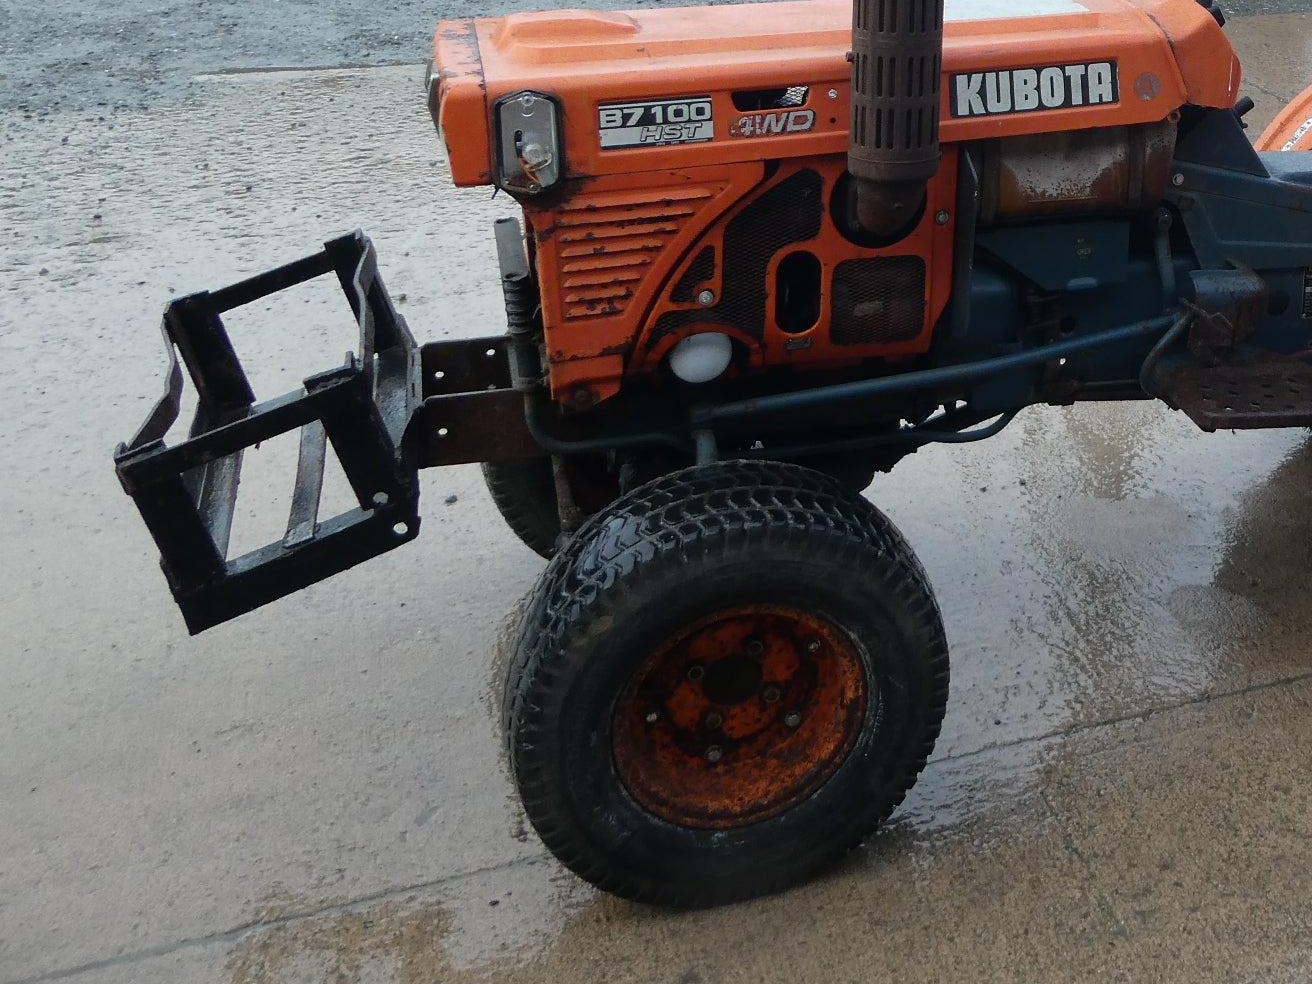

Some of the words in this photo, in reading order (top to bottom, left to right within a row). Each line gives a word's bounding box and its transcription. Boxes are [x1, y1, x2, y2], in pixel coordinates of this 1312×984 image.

[955, 62, 1113, 116] KUBOTA
[600, 102, 711, 128] B7100
[639, 122, 704, 143] HST
